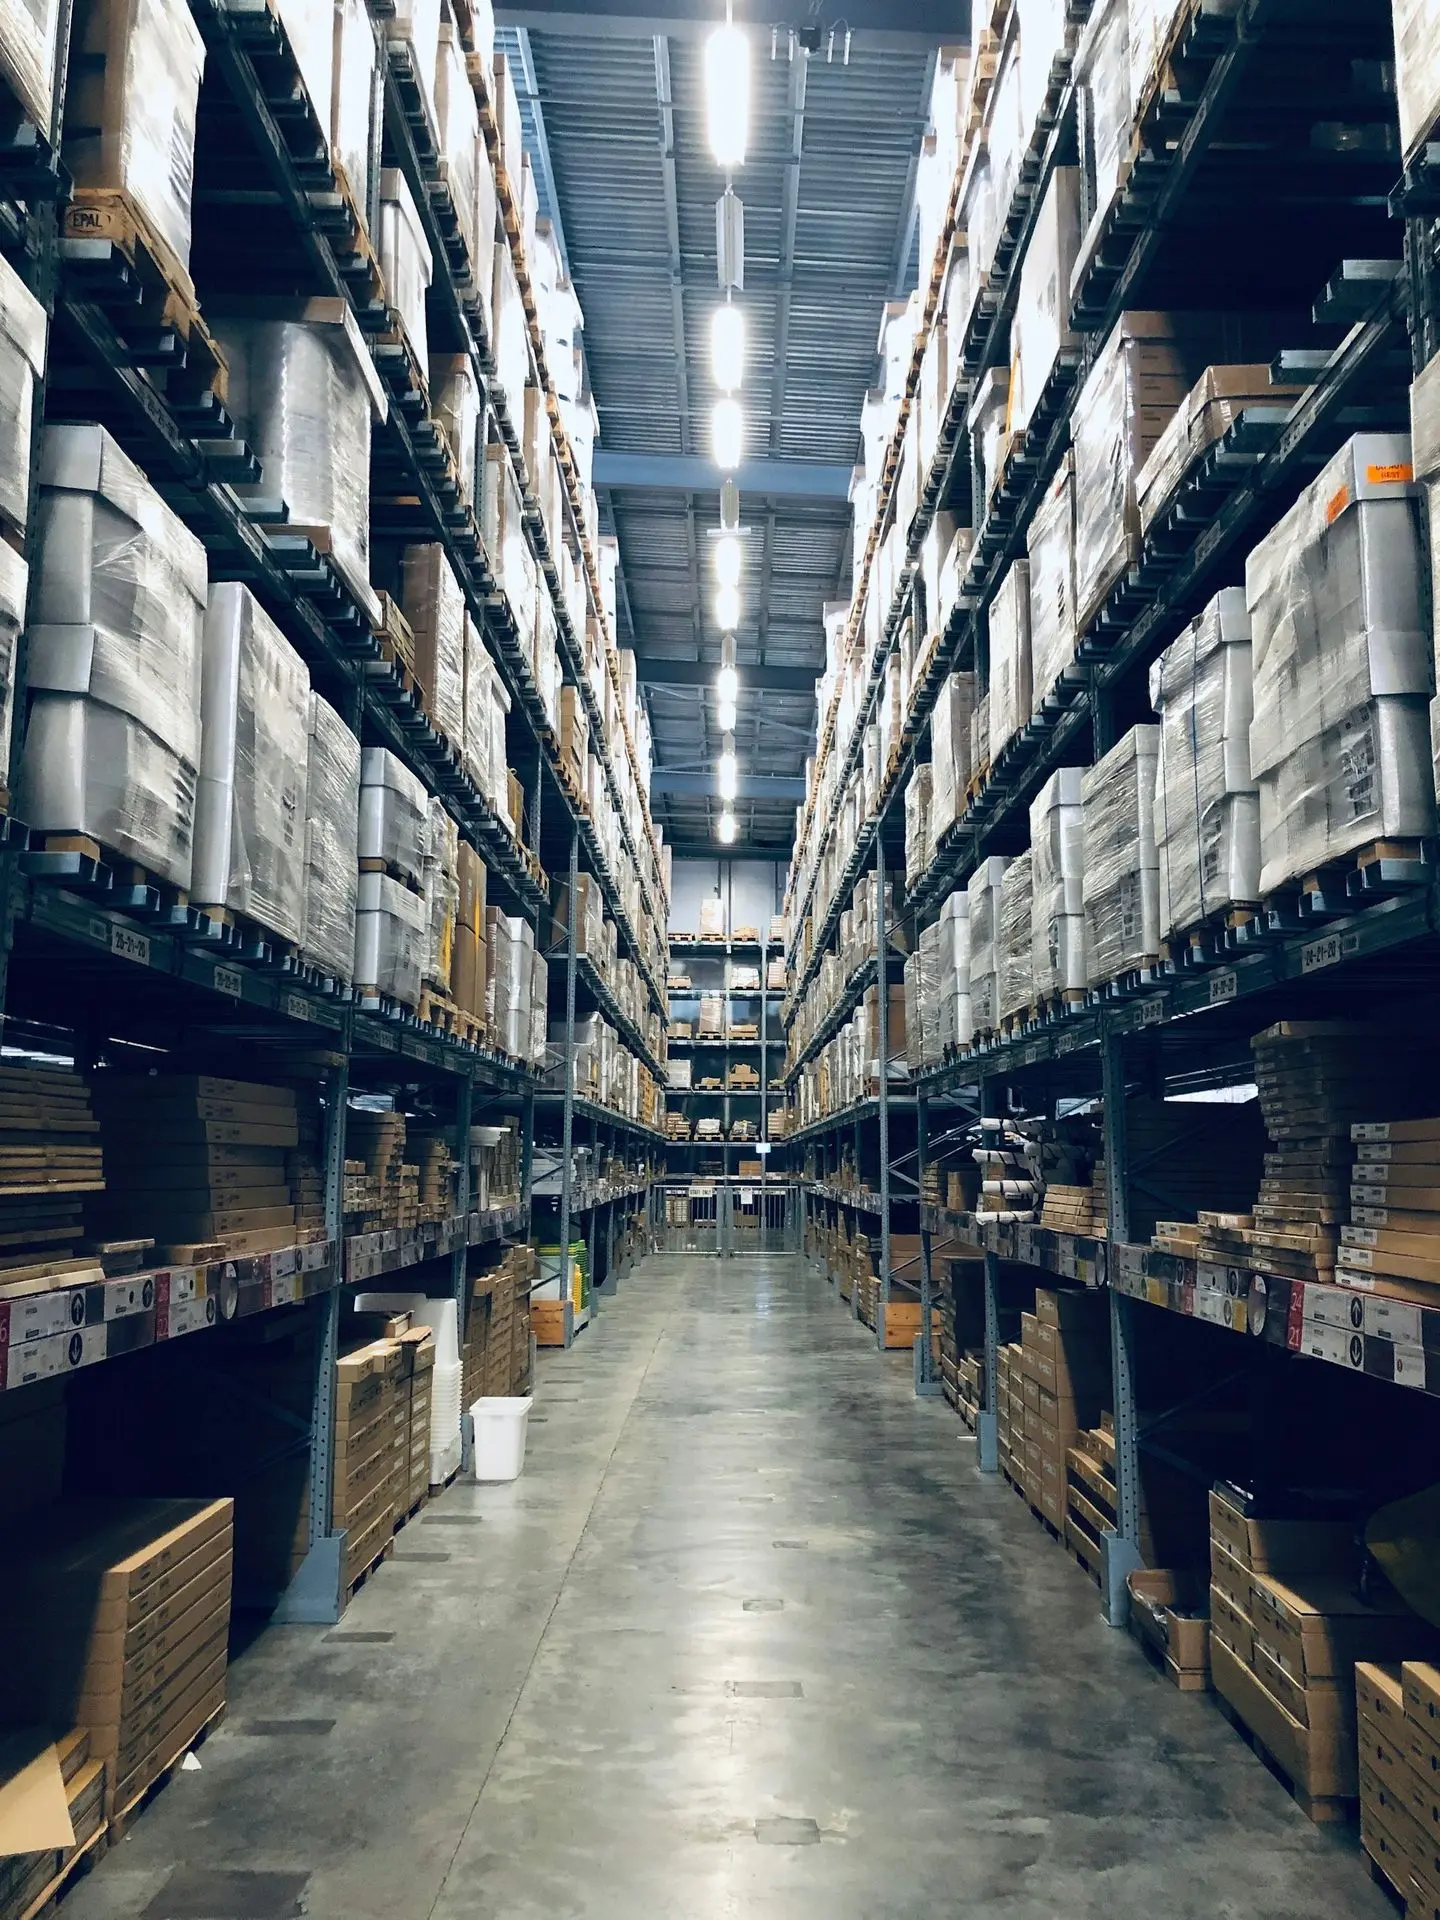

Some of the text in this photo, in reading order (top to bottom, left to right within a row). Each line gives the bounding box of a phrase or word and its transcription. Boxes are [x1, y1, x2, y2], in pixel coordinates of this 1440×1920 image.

[73, 213, 103, 228] EPAL
[1305, 939, 1337, 967] 24-21-20
[1290, 1292, 1302, 1312] 24
[1288, 1326, 1301, 1347] 21
